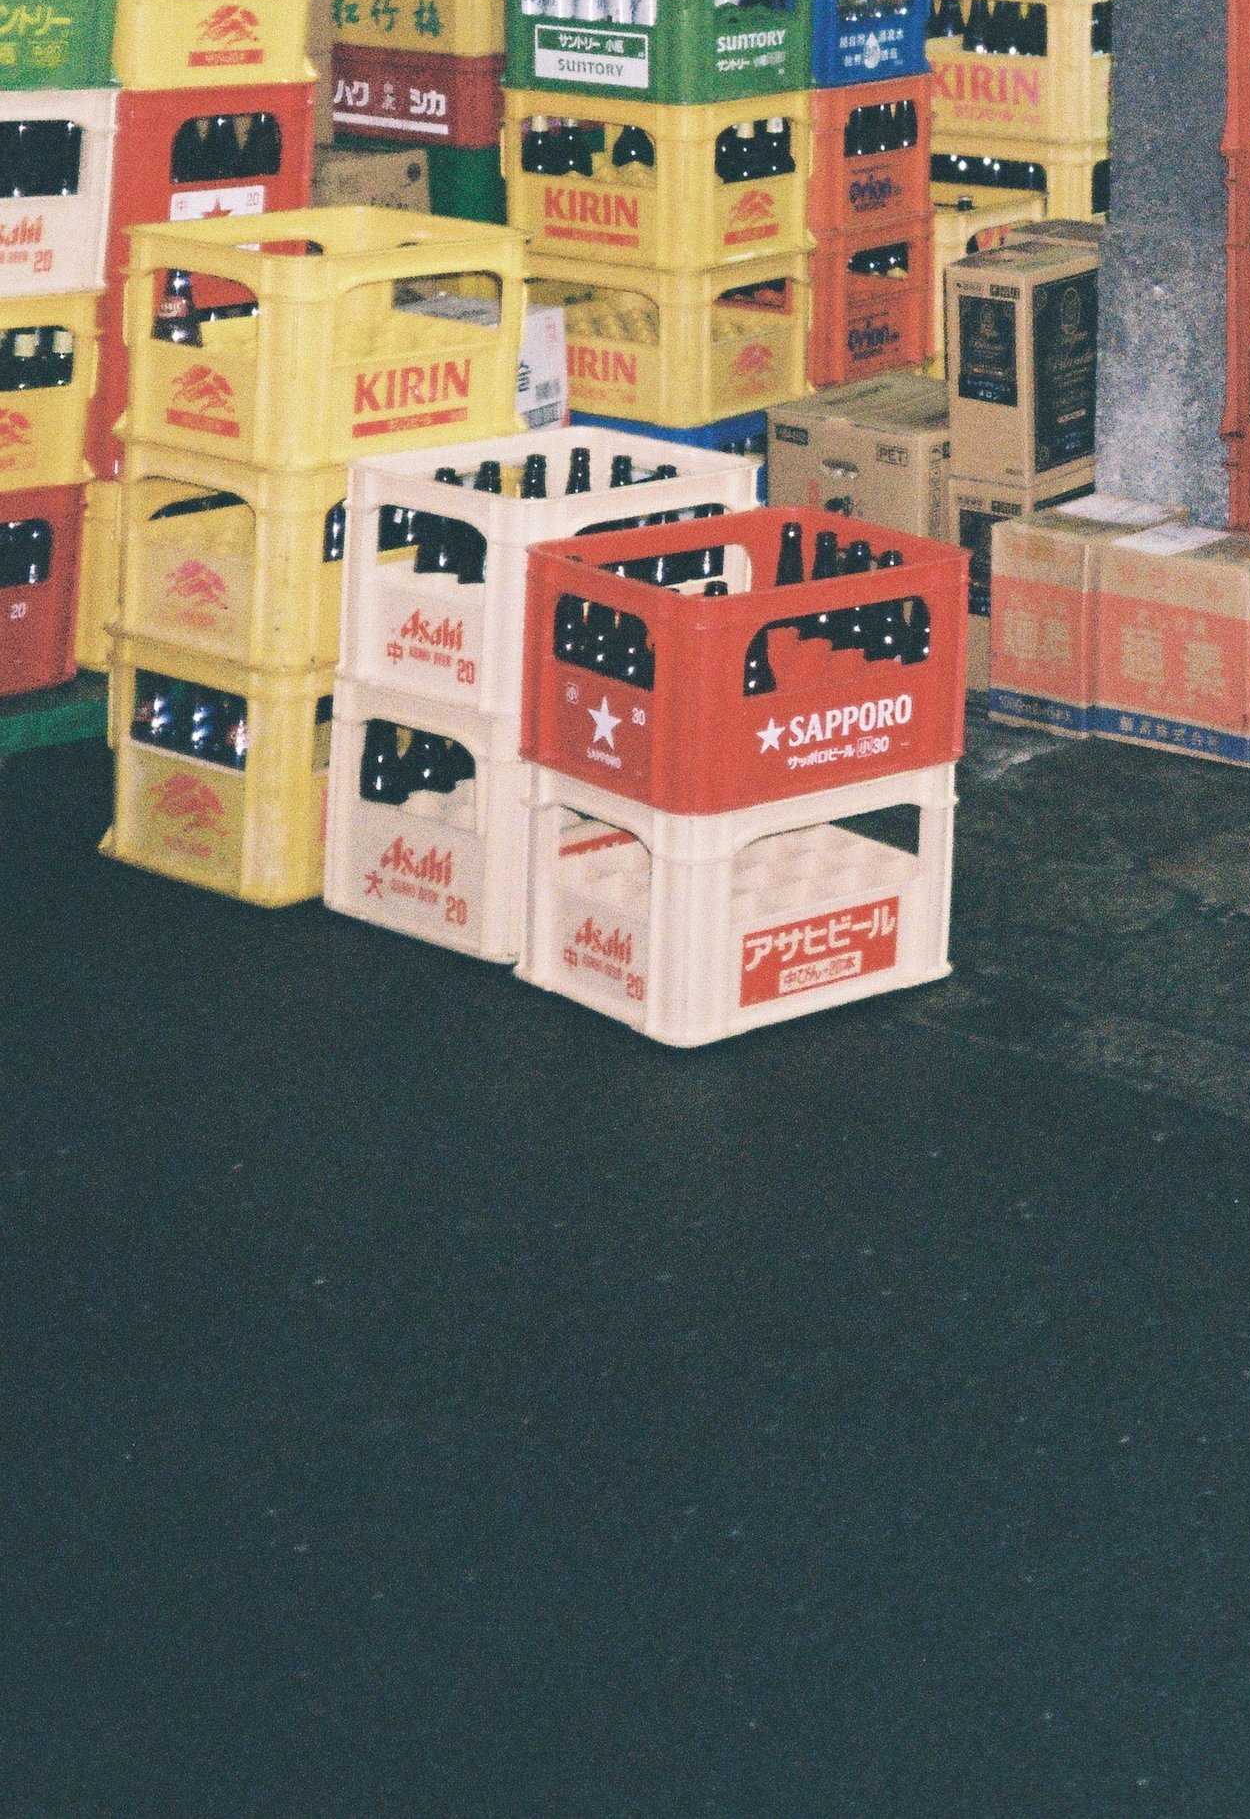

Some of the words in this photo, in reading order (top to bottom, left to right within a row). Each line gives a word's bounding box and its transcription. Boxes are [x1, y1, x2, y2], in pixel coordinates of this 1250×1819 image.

[0, 4, 72, 36] ントリー
[558, 33, 601, 51] サントリー
[716, 29, 786, 53] SUNTORY
[333, 79, 370, 108] ハク
[409, 87, 447, 118] シカ
[930, 60, 1042, 107] KIRIN
[542, 186, 640, 230] KIRIN
[0, 213, 43, 248] ahi
[566, 343, 638, 386] IRIN
[353, 358, 472, 416] KIRIN
[879, 446, 908, 466] PET
[10, 602, 27, 620] 20
[400, 608, 463, 652] Asahi
[386, 641, 404, 665] 中
[457, 658, 475, 684] 20
[631, 707, 647, 727] 30
[787, 693, 913, 747] SAPPORO
[787, 744, 855, 770] サッポロビール
[871, 735, 890, 755] 30
[380, 835, 452, 889] Asahi
[364, 870, 383, 899] 大
[445, 895, 468, 926] 20
[575, 915, 632, 965] Asahi
[745, 905, 896, 972] アサヒビール
[625, 972, 644, 1000] 20
